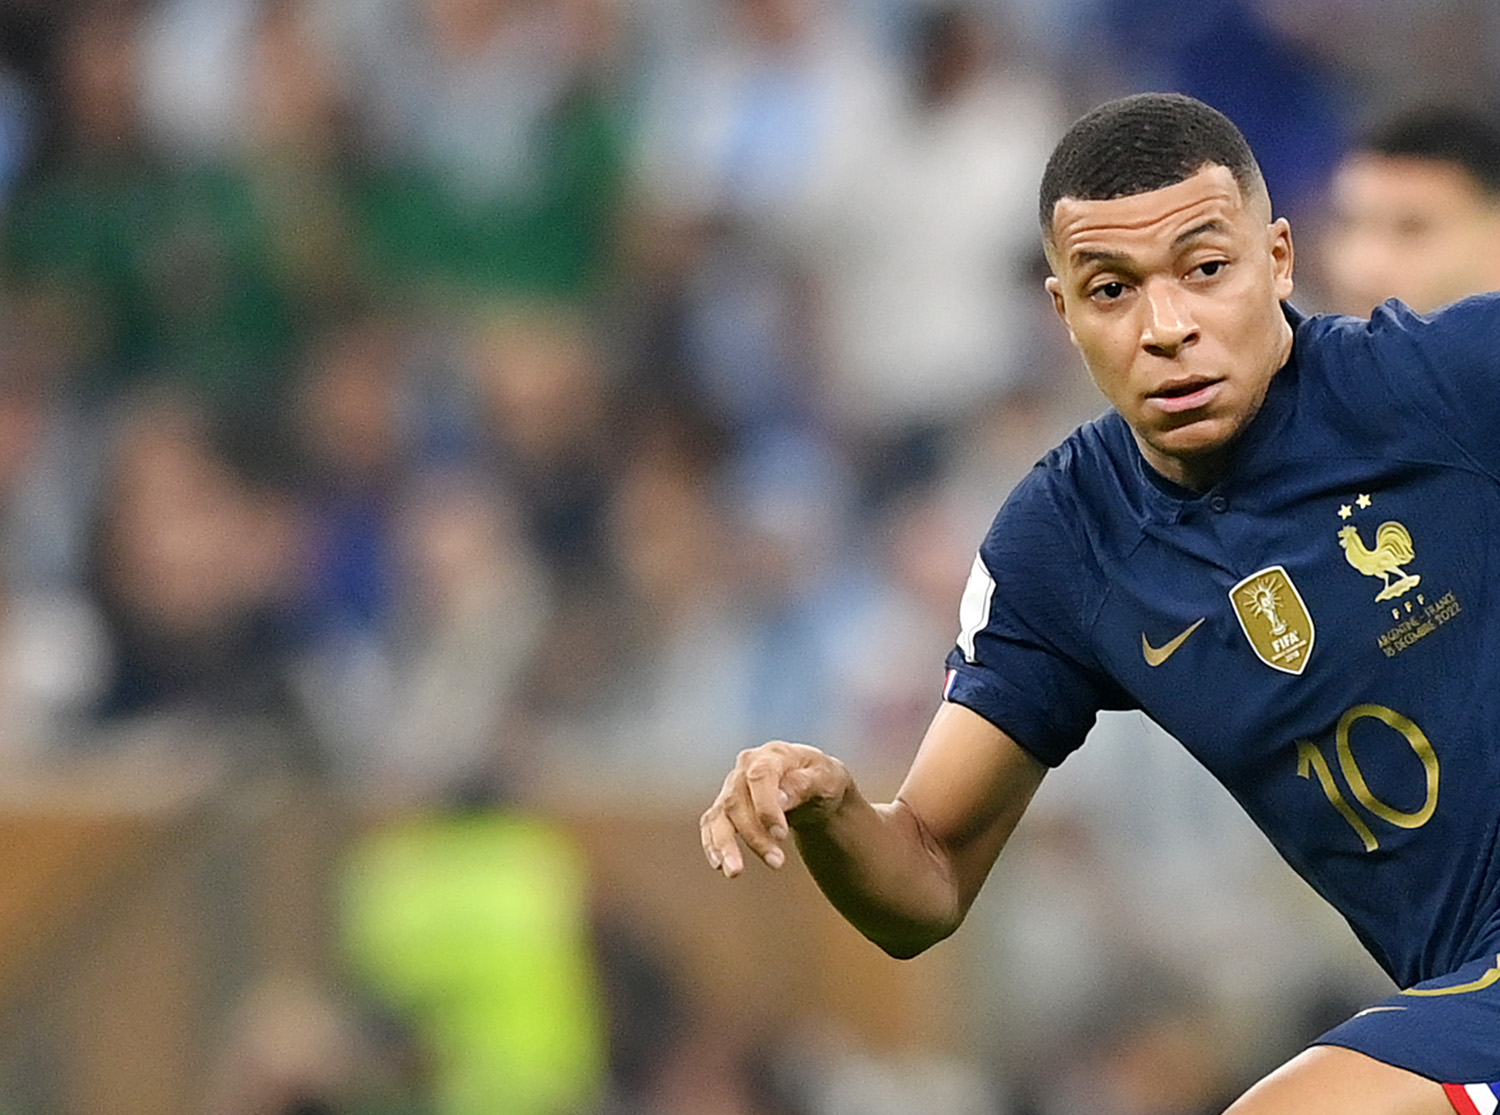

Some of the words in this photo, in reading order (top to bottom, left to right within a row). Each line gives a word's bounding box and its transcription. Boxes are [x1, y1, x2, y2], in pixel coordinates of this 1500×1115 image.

[1434, 602, 1462, 626] 2022
[1271, 632, 1299, 653] FIFA
[1295, 703, 1440, 853] 10
